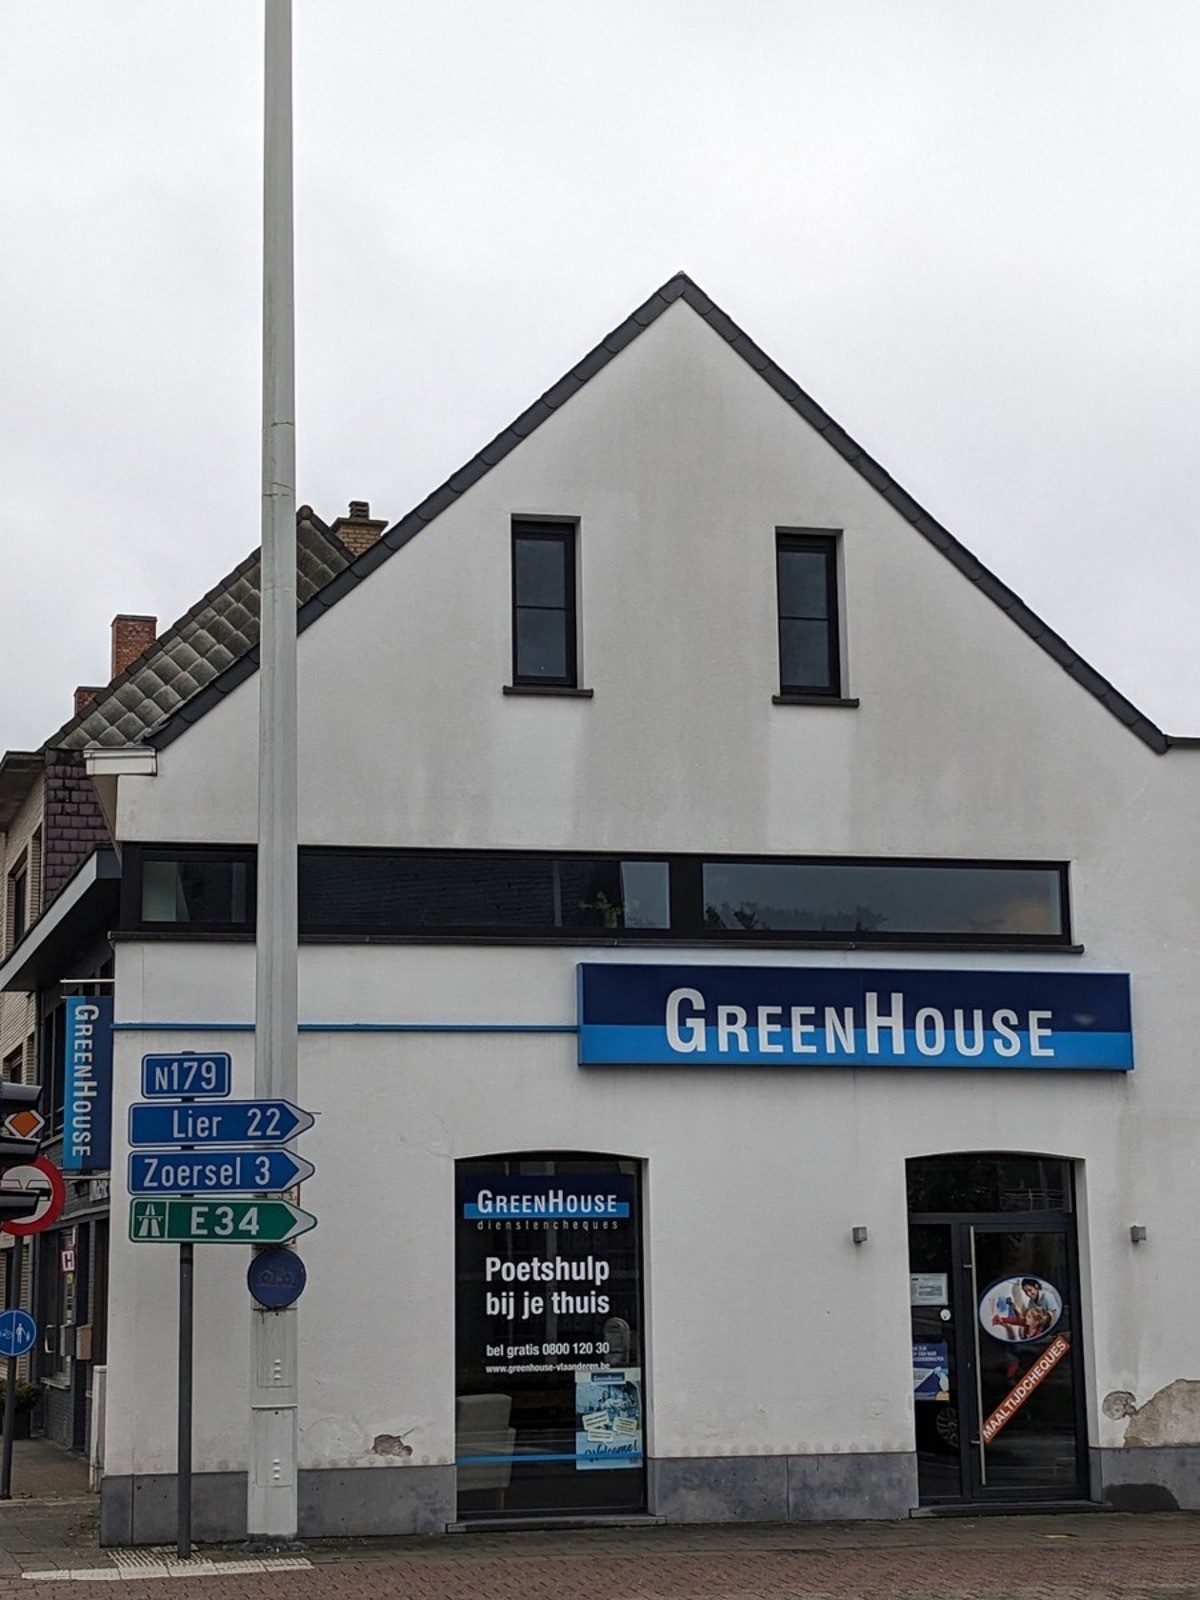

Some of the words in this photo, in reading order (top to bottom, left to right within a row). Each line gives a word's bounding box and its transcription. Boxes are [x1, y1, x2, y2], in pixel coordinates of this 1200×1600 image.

[155, 1062, 217, 1090] N179
[172, 1109, 222, 1138] Lier
[247, 1108, 281, 1136] 22
[143, 1157, 241, 1188] Zoersel
[255, 1156, 270, 1185] 3
[190, 1206, 260, 1236] E34
[477, 1219, 618, 1230] dienstencheques
[485, 1256, 610, 1286] Poetshulp
[486, 1292, 514, 1320] bij
[522, 1291, 544, 1320] je
[552, 1291, 610, 1314] thuis
[486, 1344, 504, 1357] bel
[507, 1343, 540, 1359] gratis
[542, 1343, 570, 1356] 0800
[572, 1342, 593, 1355] 120
[595, 1342, 610, 1354] 30
[485, 1361, 611, 1375] www.greenhouse-vlaanderen.be
[982, 1339, 1068, 1440] MAALTIJDCHEQUES
